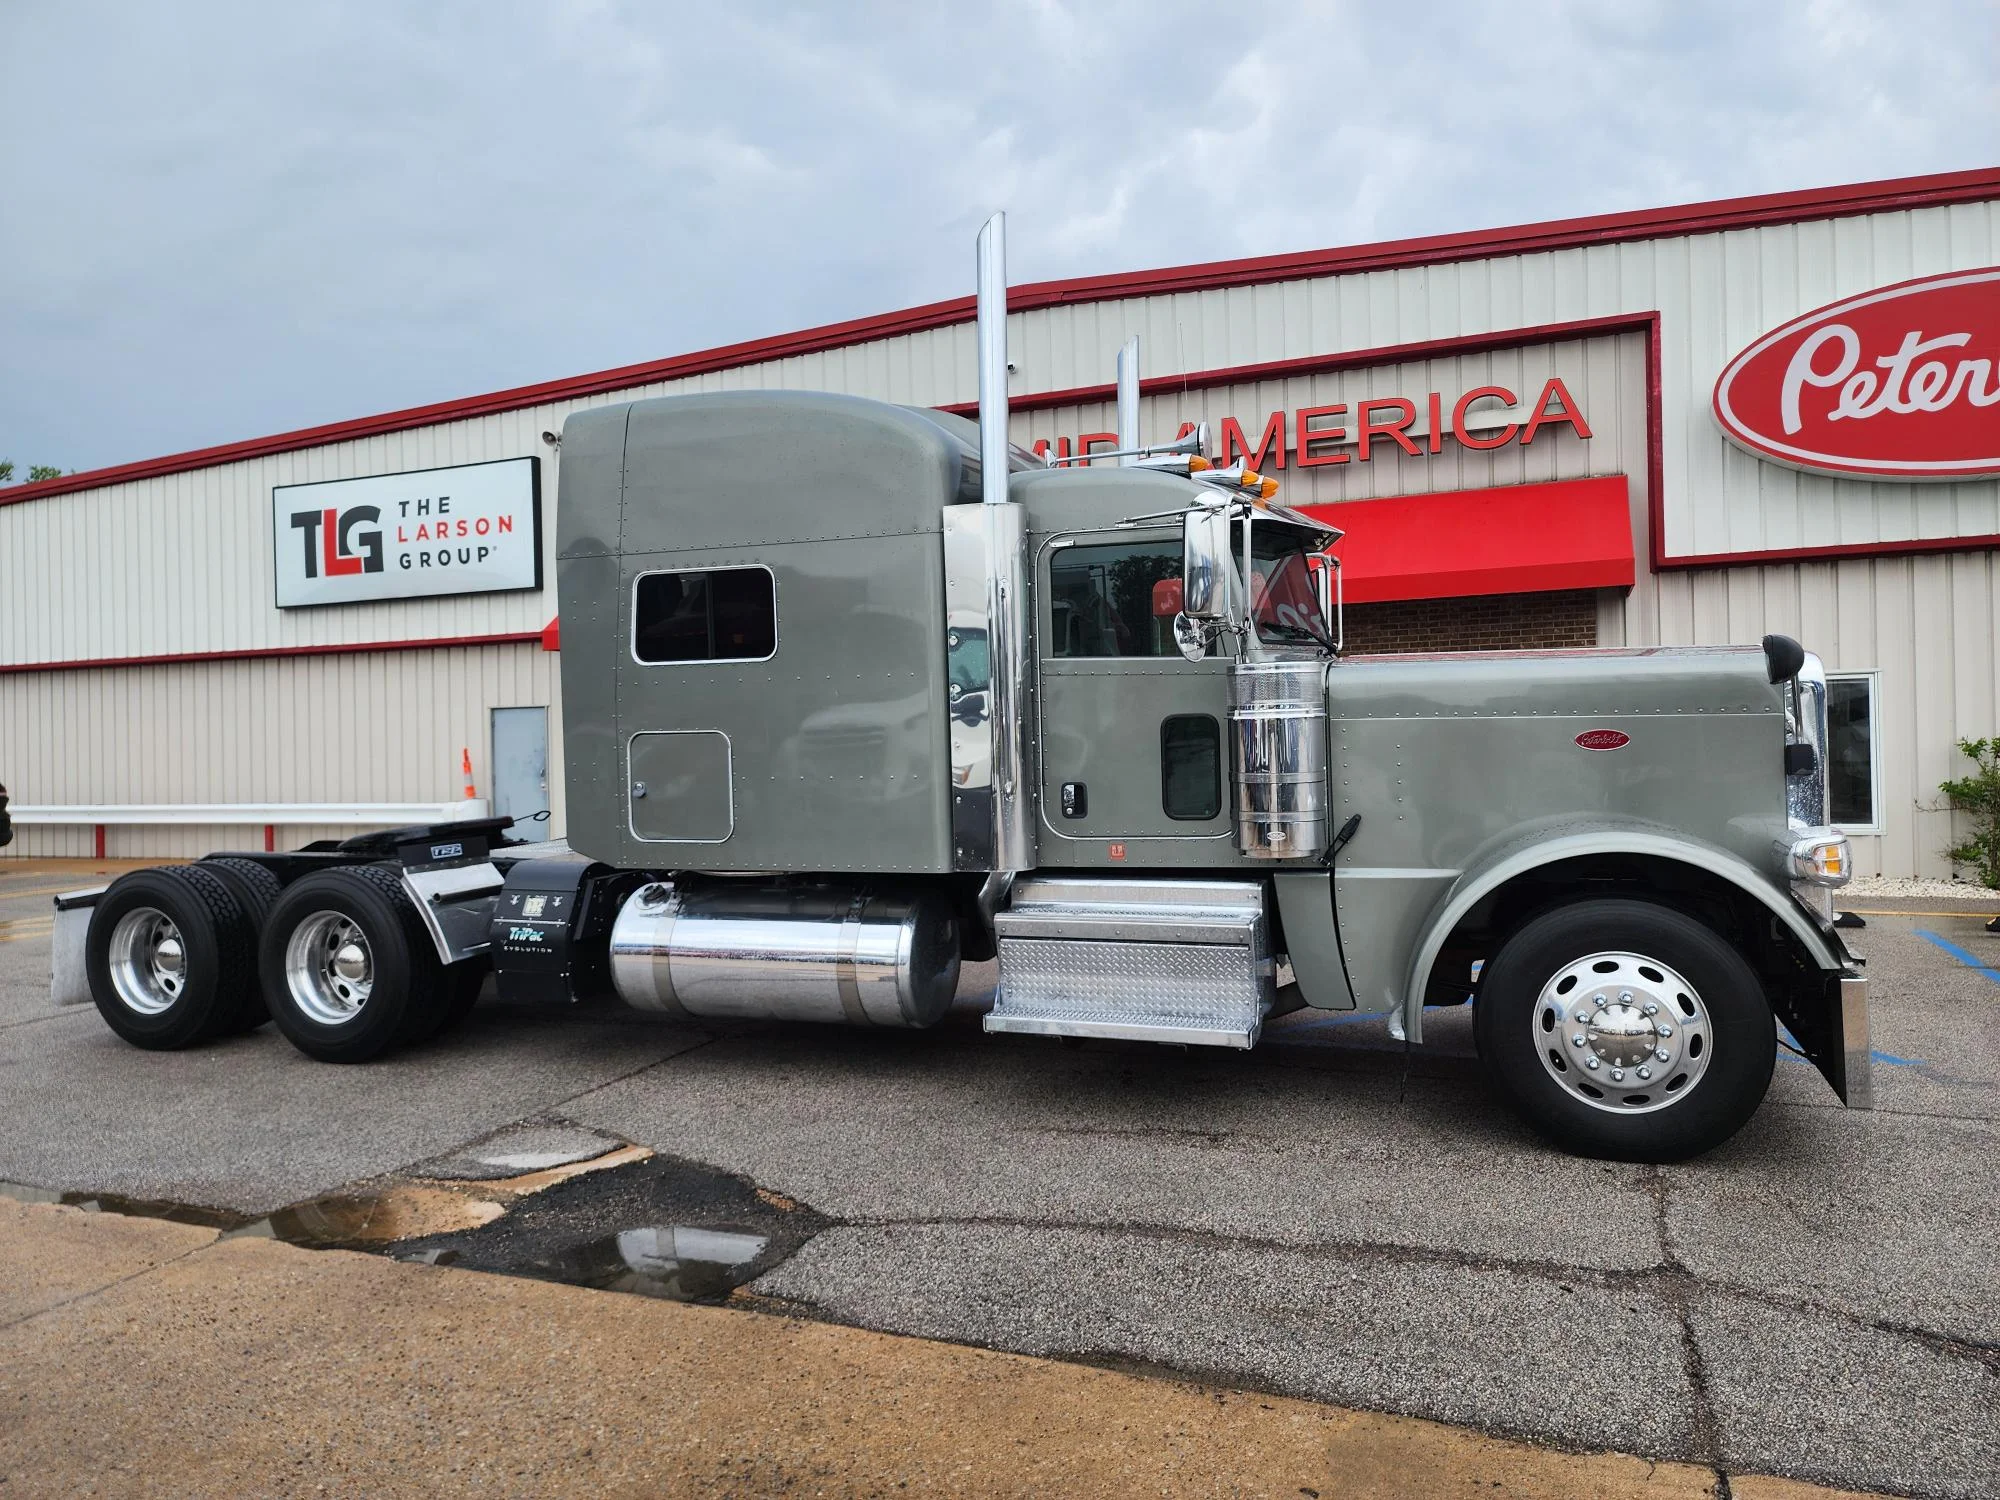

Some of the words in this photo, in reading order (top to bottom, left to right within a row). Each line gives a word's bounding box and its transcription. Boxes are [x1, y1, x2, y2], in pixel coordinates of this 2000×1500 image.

[1781, 323, 2000, 436] Peter
[398, 496, 451, 518] THE
[290, 504, 385, 579] TLG
[398, 514, 513, 543] LARSON
[399, 546, 490, 570] GROUP
[509, 926, 545, 942] TriPac
